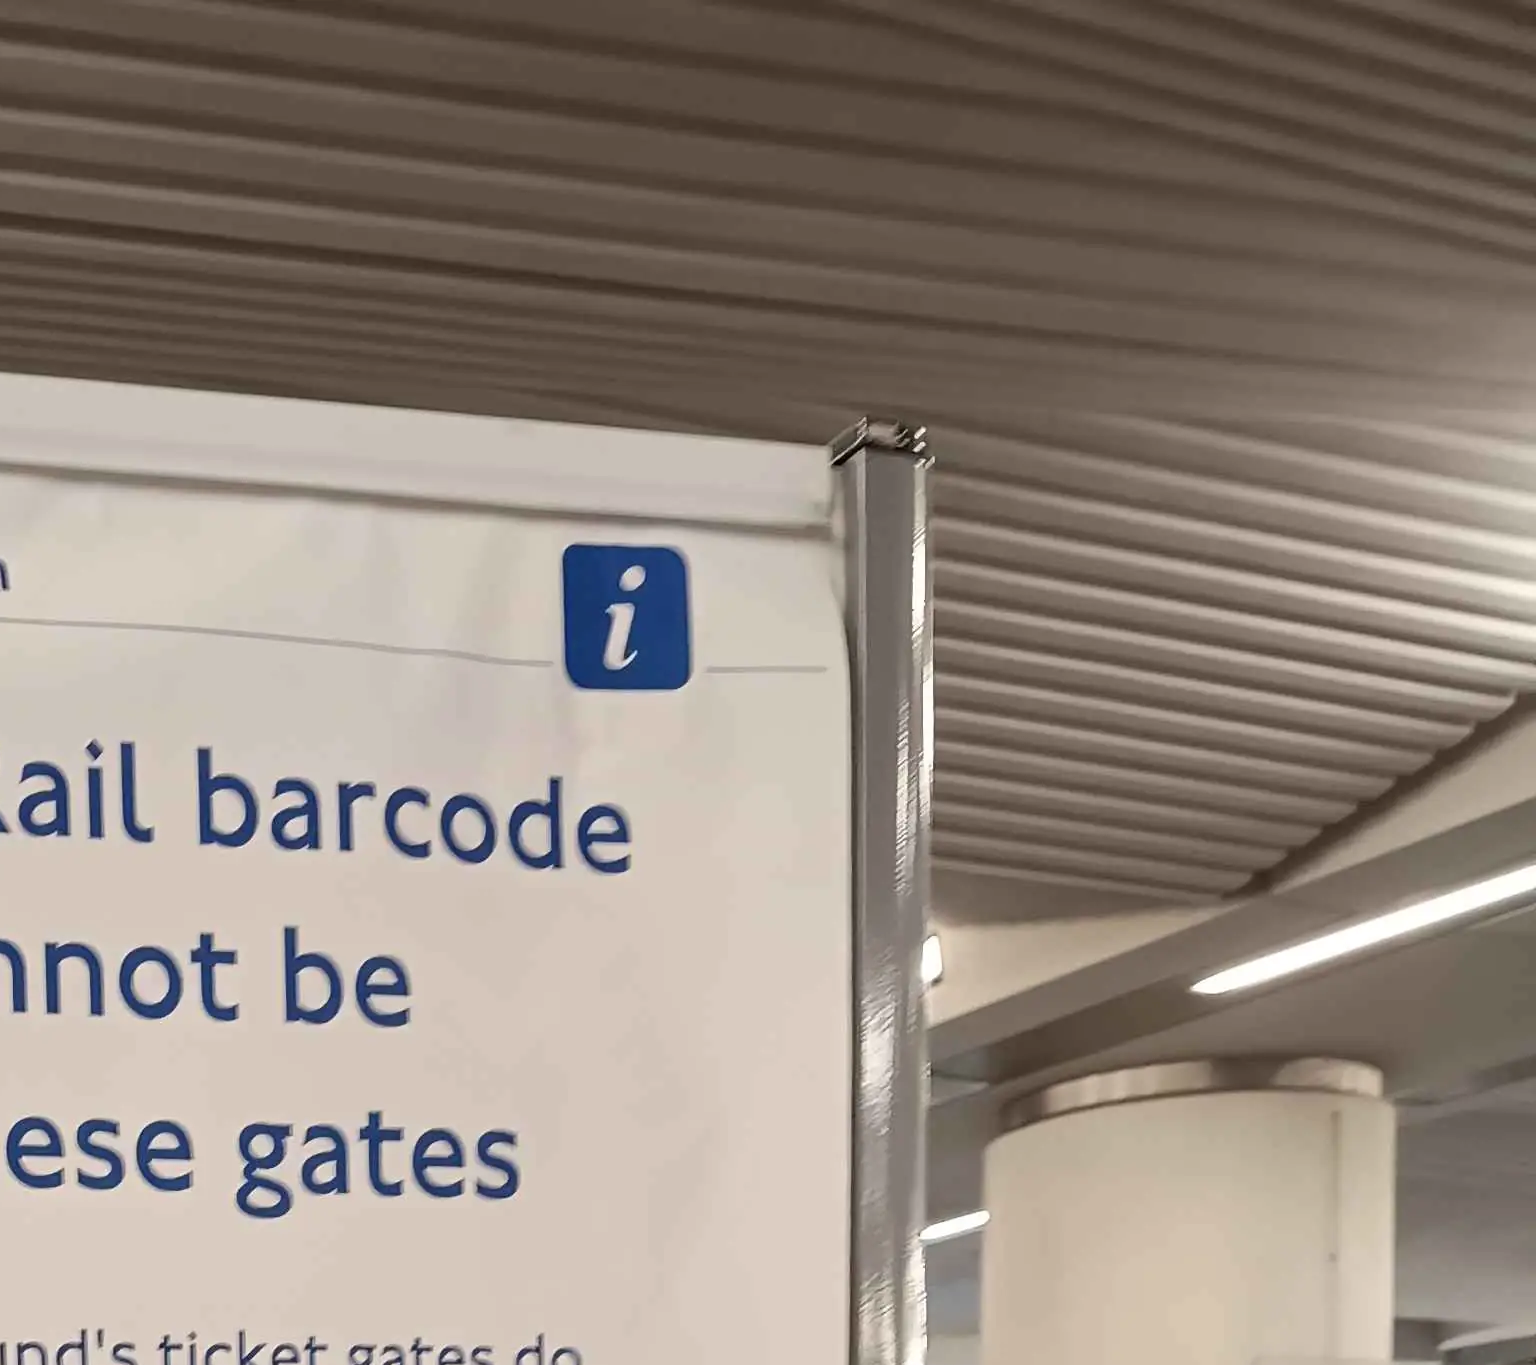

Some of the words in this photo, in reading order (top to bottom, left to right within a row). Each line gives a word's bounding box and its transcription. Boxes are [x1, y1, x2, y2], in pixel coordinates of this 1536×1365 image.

[197, 748, 630, 873] barcode
[284, 927, 410, 1027] be
[236, 1111, 520, 1219] gates
